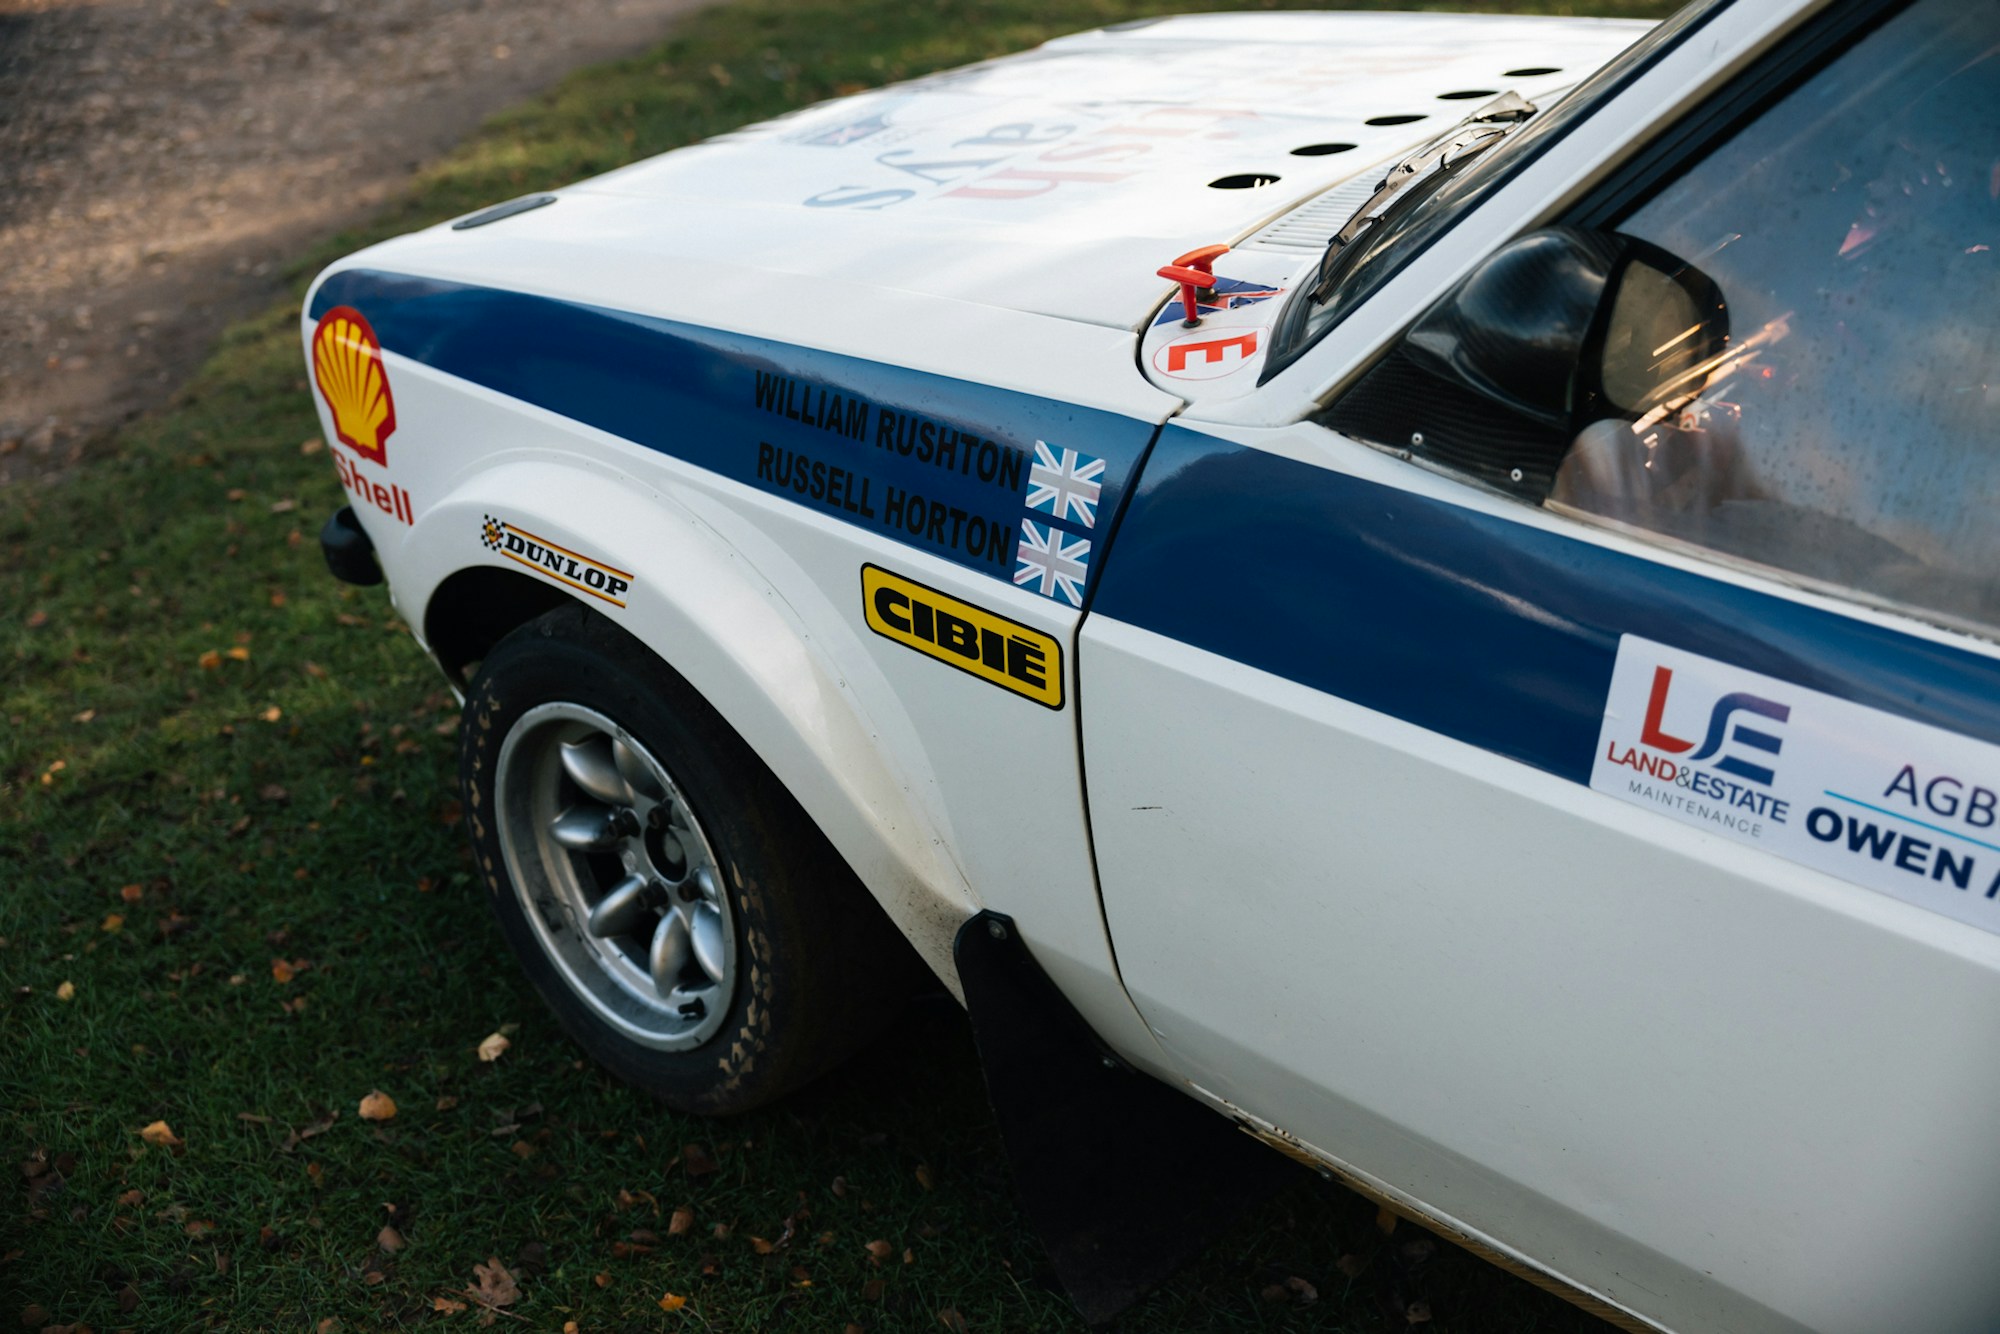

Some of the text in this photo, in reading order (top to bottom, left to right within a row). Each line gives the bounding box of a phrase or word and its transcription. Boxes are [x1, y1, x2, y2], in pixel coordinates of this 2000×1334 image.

[1167, 330, 1258, 372] E
[755, 369, 1025, 492] WILLIAM RUSHTON
[331, 447, 414, 526] Shell
[757, 441, 1011, 566] RUSSELL HORTON
[504, 532, 628, 596] DUNLOP
[1628, 779, 1763, 839] MAINTENANCE
[1806, 806, 1975, 890] OWEN
